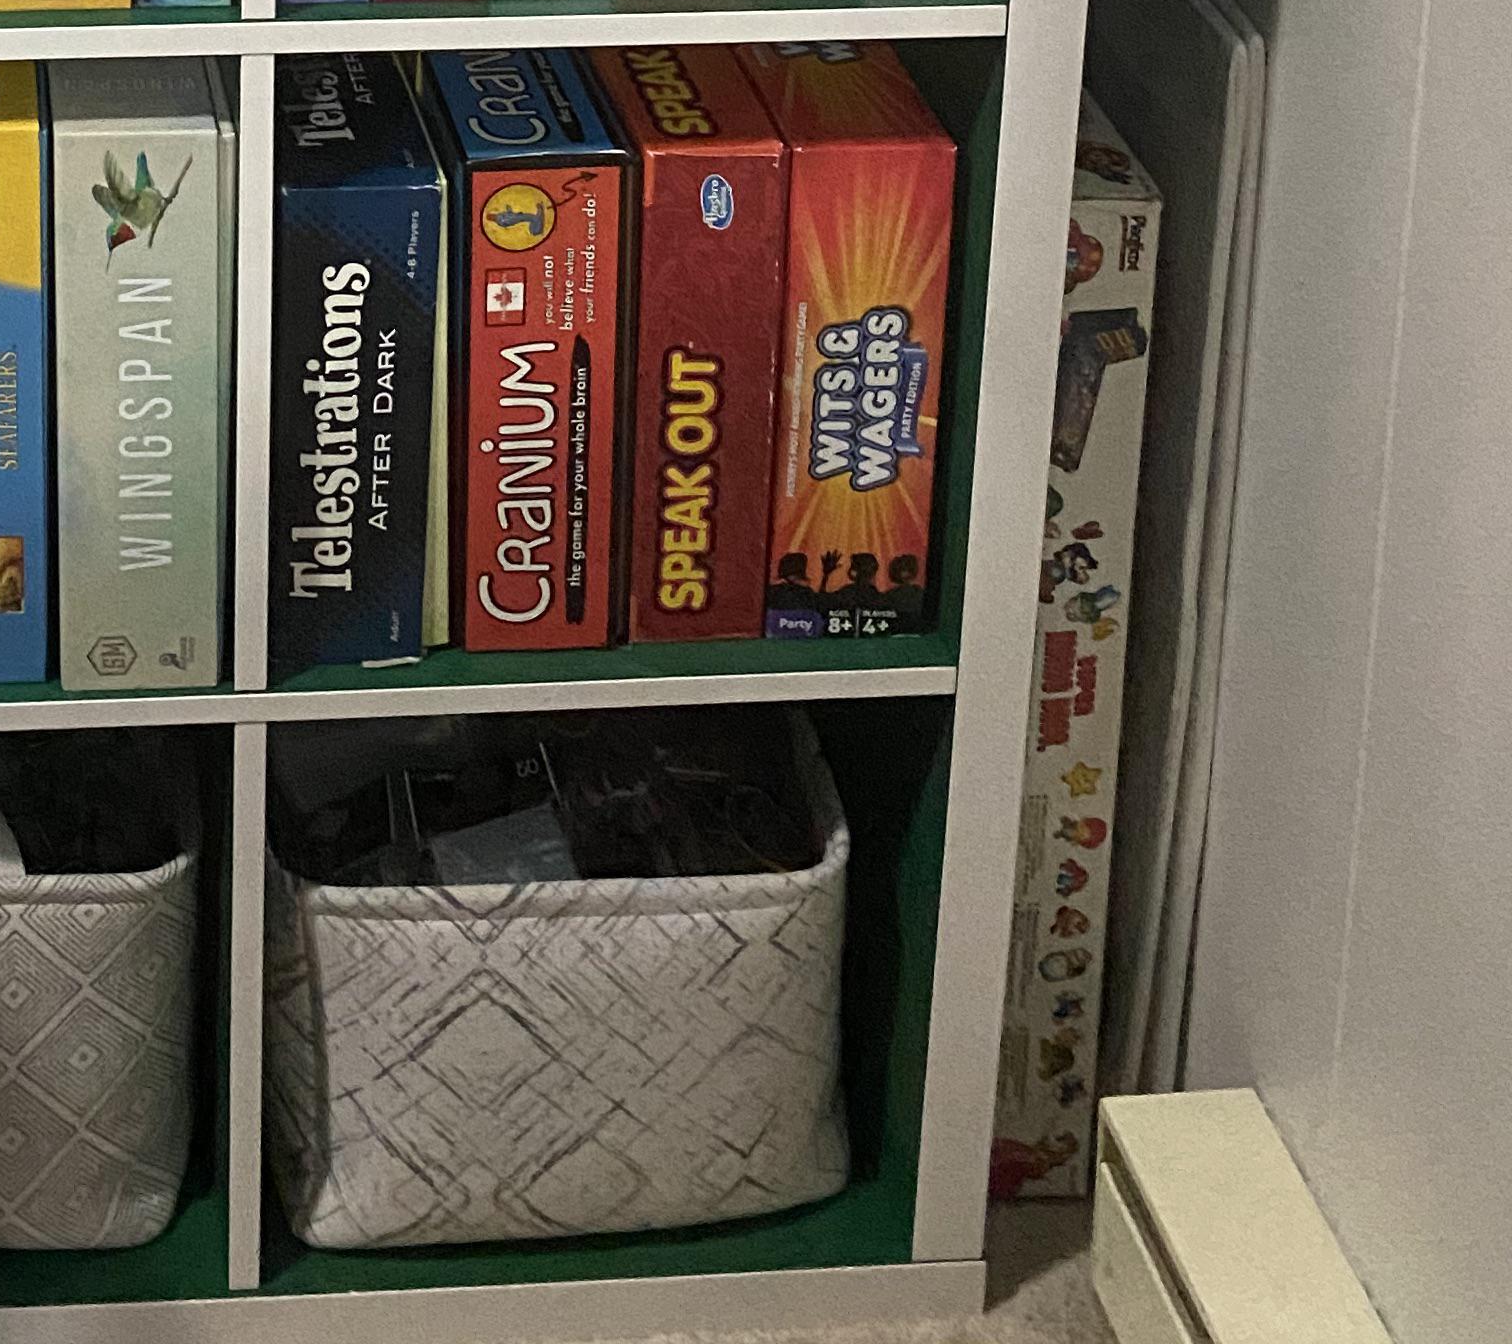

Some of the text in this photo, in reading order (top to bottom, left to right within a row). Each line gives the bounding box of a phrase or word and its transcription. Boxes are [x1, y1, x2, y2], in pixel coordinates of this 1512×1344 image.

[559, 247, 575, 331] believe what
[120, 274, 174, 572] WINGSPAN
[289, 260, 371, 598] Telestrations
[366, 326, 397, 532] AFTER DARK
[569, 367, 587, 587] the game for your whole brain
[658, 352, 719, 612] SPEAK OUT
[855, 312, 906, 487] WAGERS
[900, 361, 923, 439] PARTY EDITION
[779, 617, 813, 632] Party
[827, 618, 889, 634] 8+ 4+
